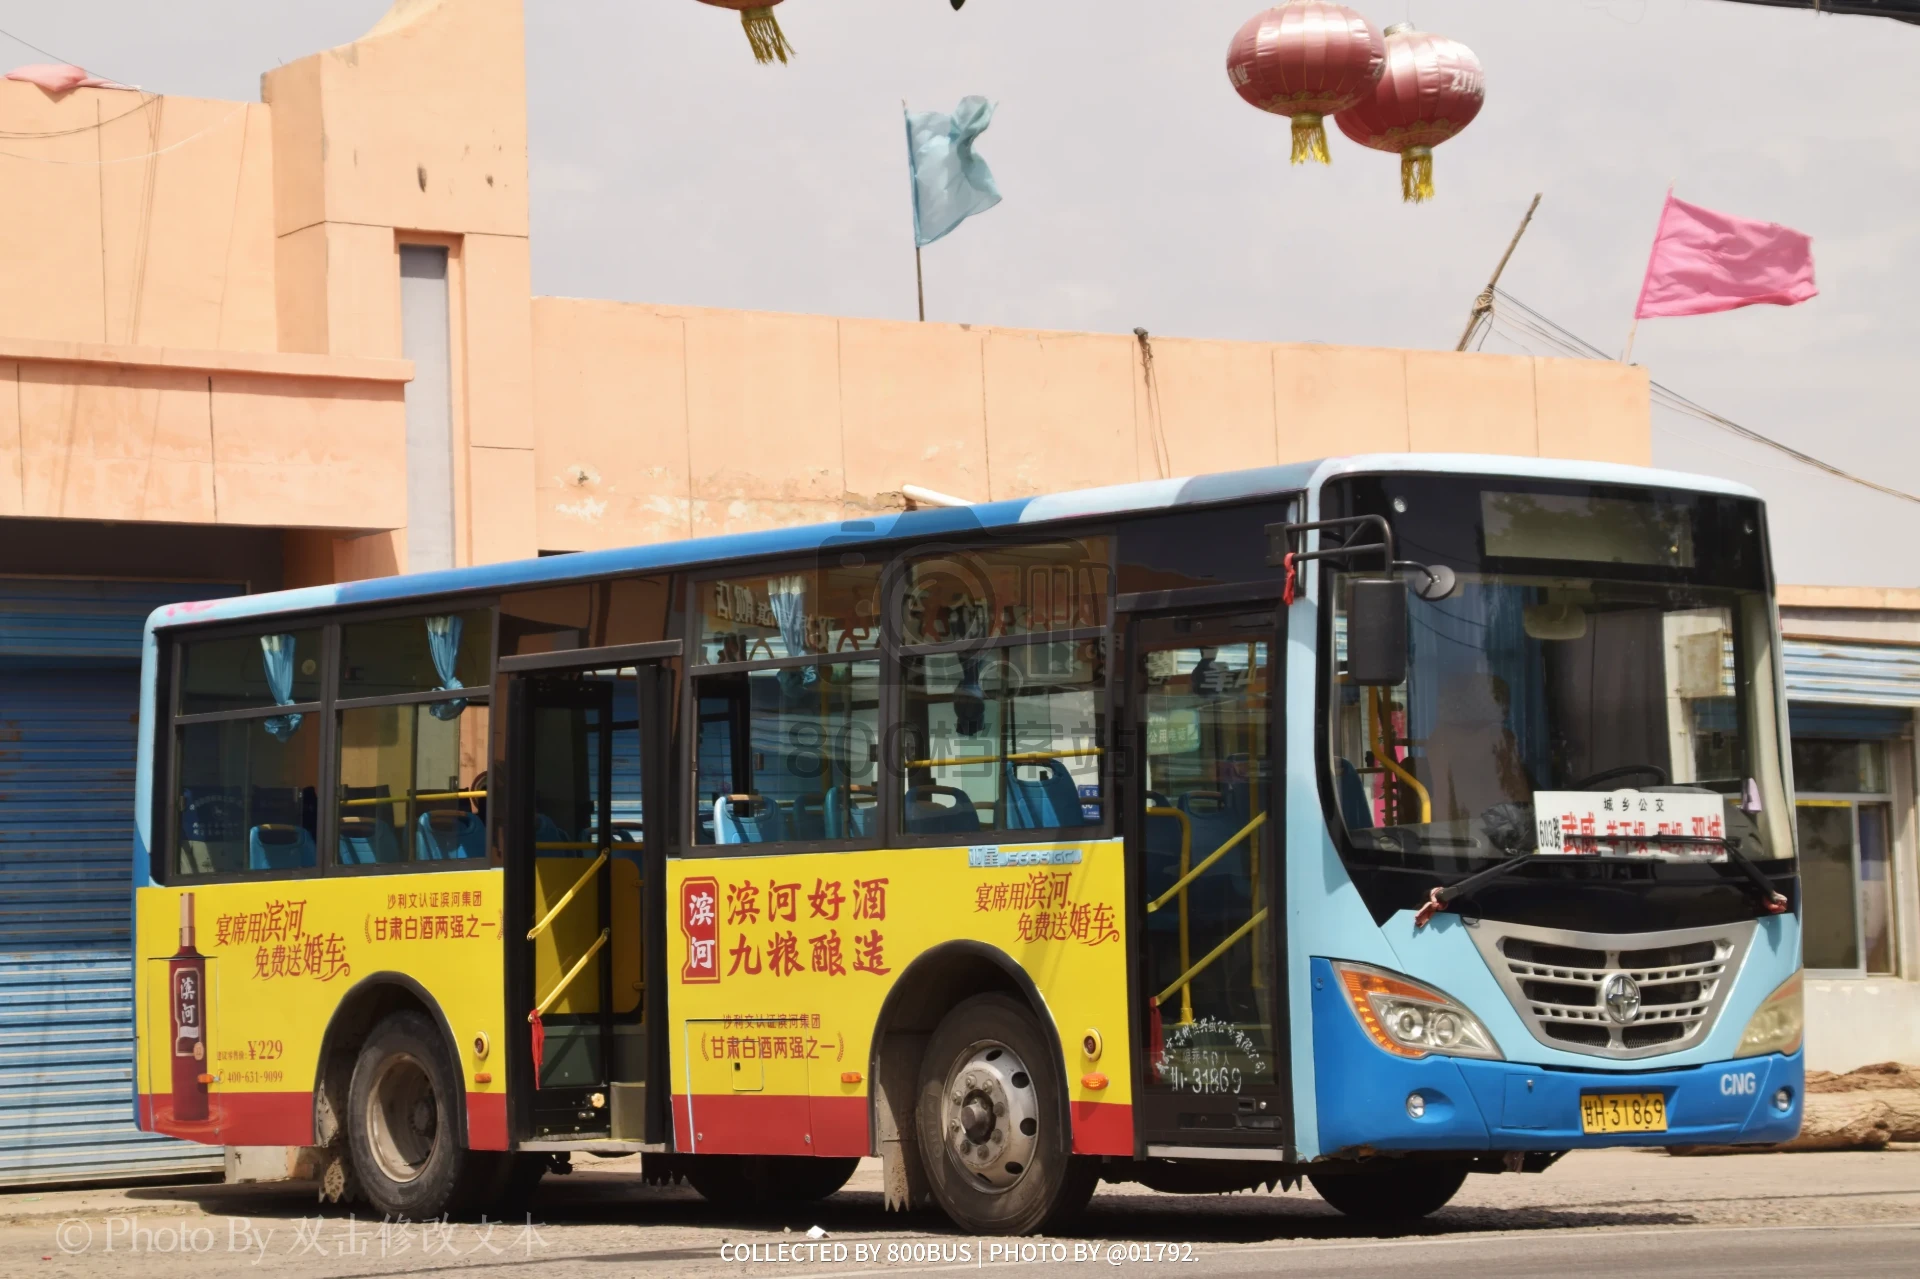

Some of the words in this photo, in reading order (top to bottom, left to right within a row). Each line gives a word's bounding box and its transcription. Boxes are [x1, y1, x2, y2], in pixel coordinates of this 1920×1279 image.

[1603, 797, 1665, 813] 城乡公交
[1561, 811, 1598, 855] 武威
[387, 890, 482, 910] 沙利文认证滨河集团
[727, 877, 889, 926] 滨河好酒
[374, 914, 496, 942] 甘肃白酒两强之一
[689, 892, 716, 969] 滨河
[1014, 902, 1120, 946] 免费送婚车
[252, 933, 350, 981] 免费送婚车
[727, 929, 892, 977] 九粮酿造
[180, 976, 196, 1024] 滨河
[248, 1040, 284, 1060] ¥229
[711, 1035, 836, 1060] 甘肃白酒两强之一
[227, 1070, 284, 1083] 400-631-9099
[1720, 1072, 1756, 1096] CNG
